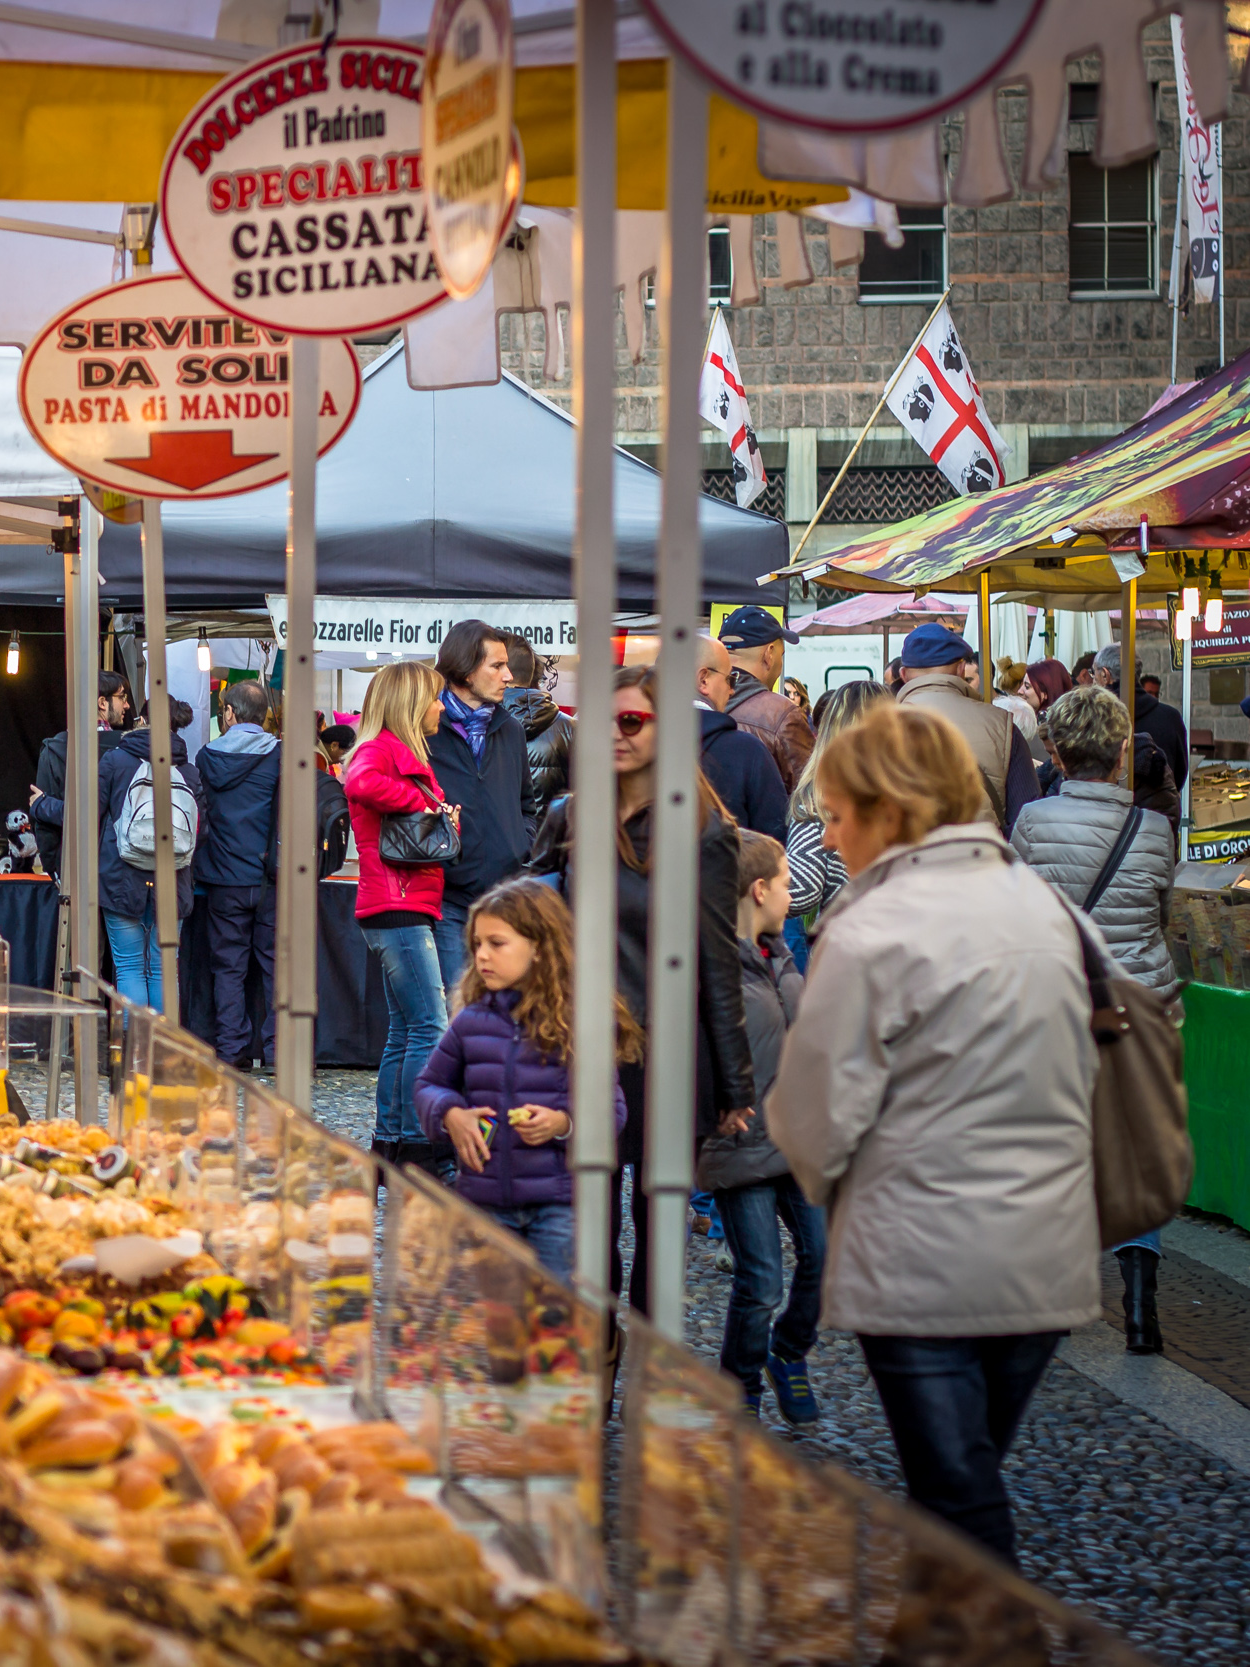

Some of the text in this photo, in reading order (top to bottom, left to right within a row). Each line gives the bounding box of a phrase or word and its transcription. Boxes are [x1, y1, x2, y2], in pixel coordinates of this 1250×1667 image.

[780, 3, 944, 49] Cioccolato
[767, 49, 829, 89] alla
[841, 54, 941, 97] Crema
[183, 51, 423, 175] DOLCEZZE SICIL
[283, 112, 299, 150] il
[304, 104, 387, 147] Padrino
[207, 147, 424, 218] SPECIALIT
[233, 251, 442, 300] SICILIANA
[78, 356, 159, 389] DA
[44, 390, 338, 424] PASTA di MANDOA
[312, 617, 384, 643] zzarelle
[390, 619, 422, 643] Fior
[427, 620, 442, 643] di
[1222, 625, 1232, 633] di
[1204, 845, 1217, 858] DI
